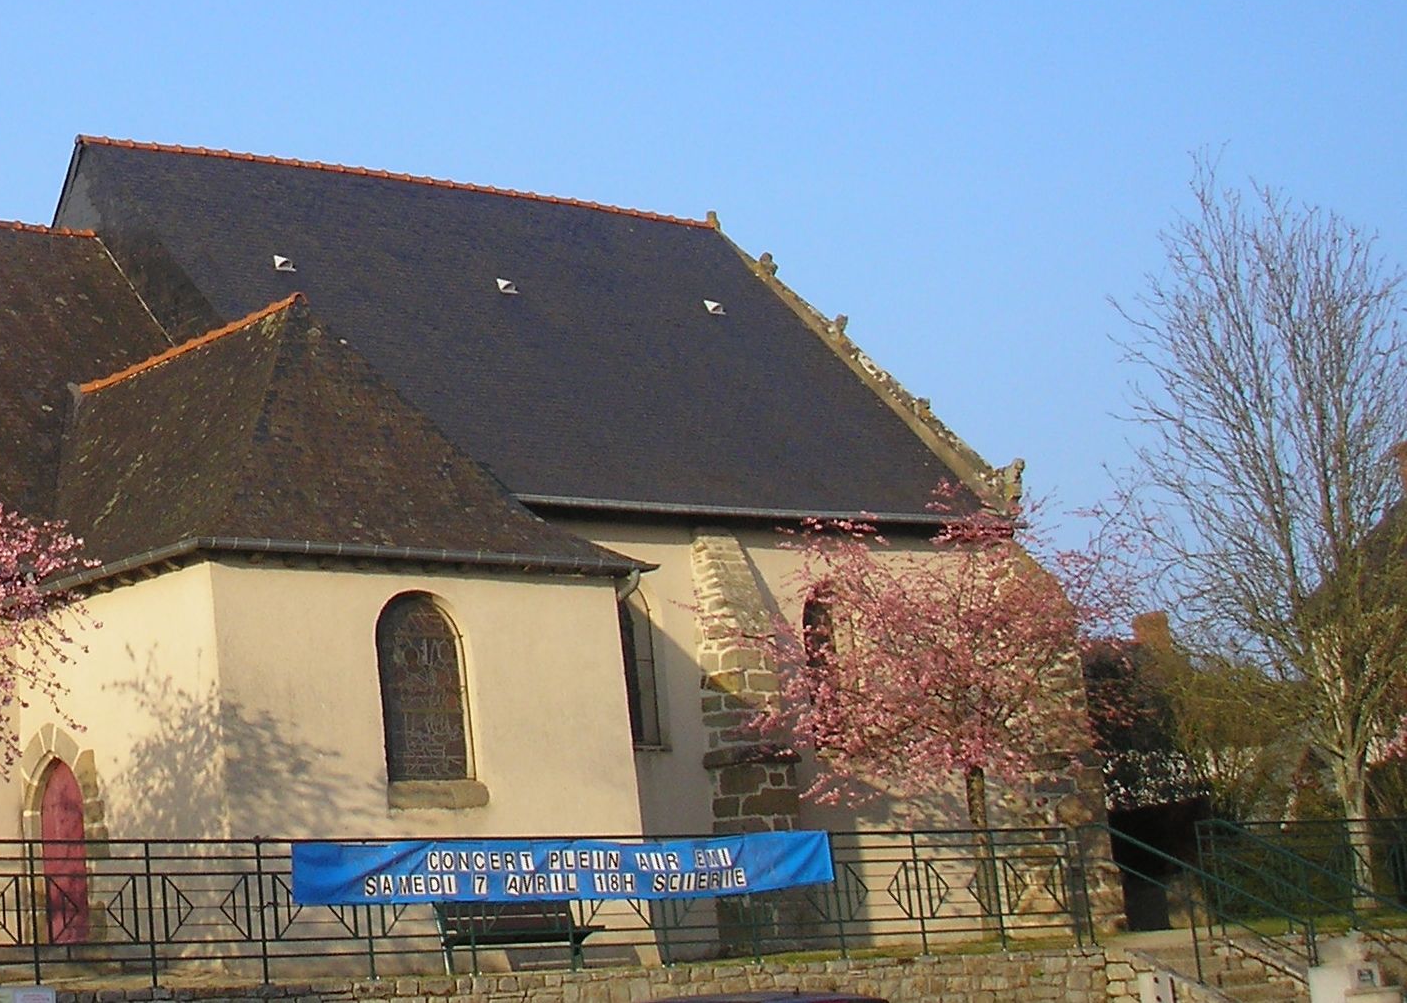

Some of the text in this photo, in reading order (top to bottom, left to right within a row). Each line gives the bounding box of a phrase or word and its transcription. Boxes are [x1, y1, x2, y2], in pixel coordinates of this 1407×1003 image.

[428, 852, 533, 871] CONCERT
[550, 851, 619, 870] PLEIN
[638, 853, 678, 870] AIR
[366, 869, 745, 895] SAMEDI 7 AVRIL 18H SCIERIE
